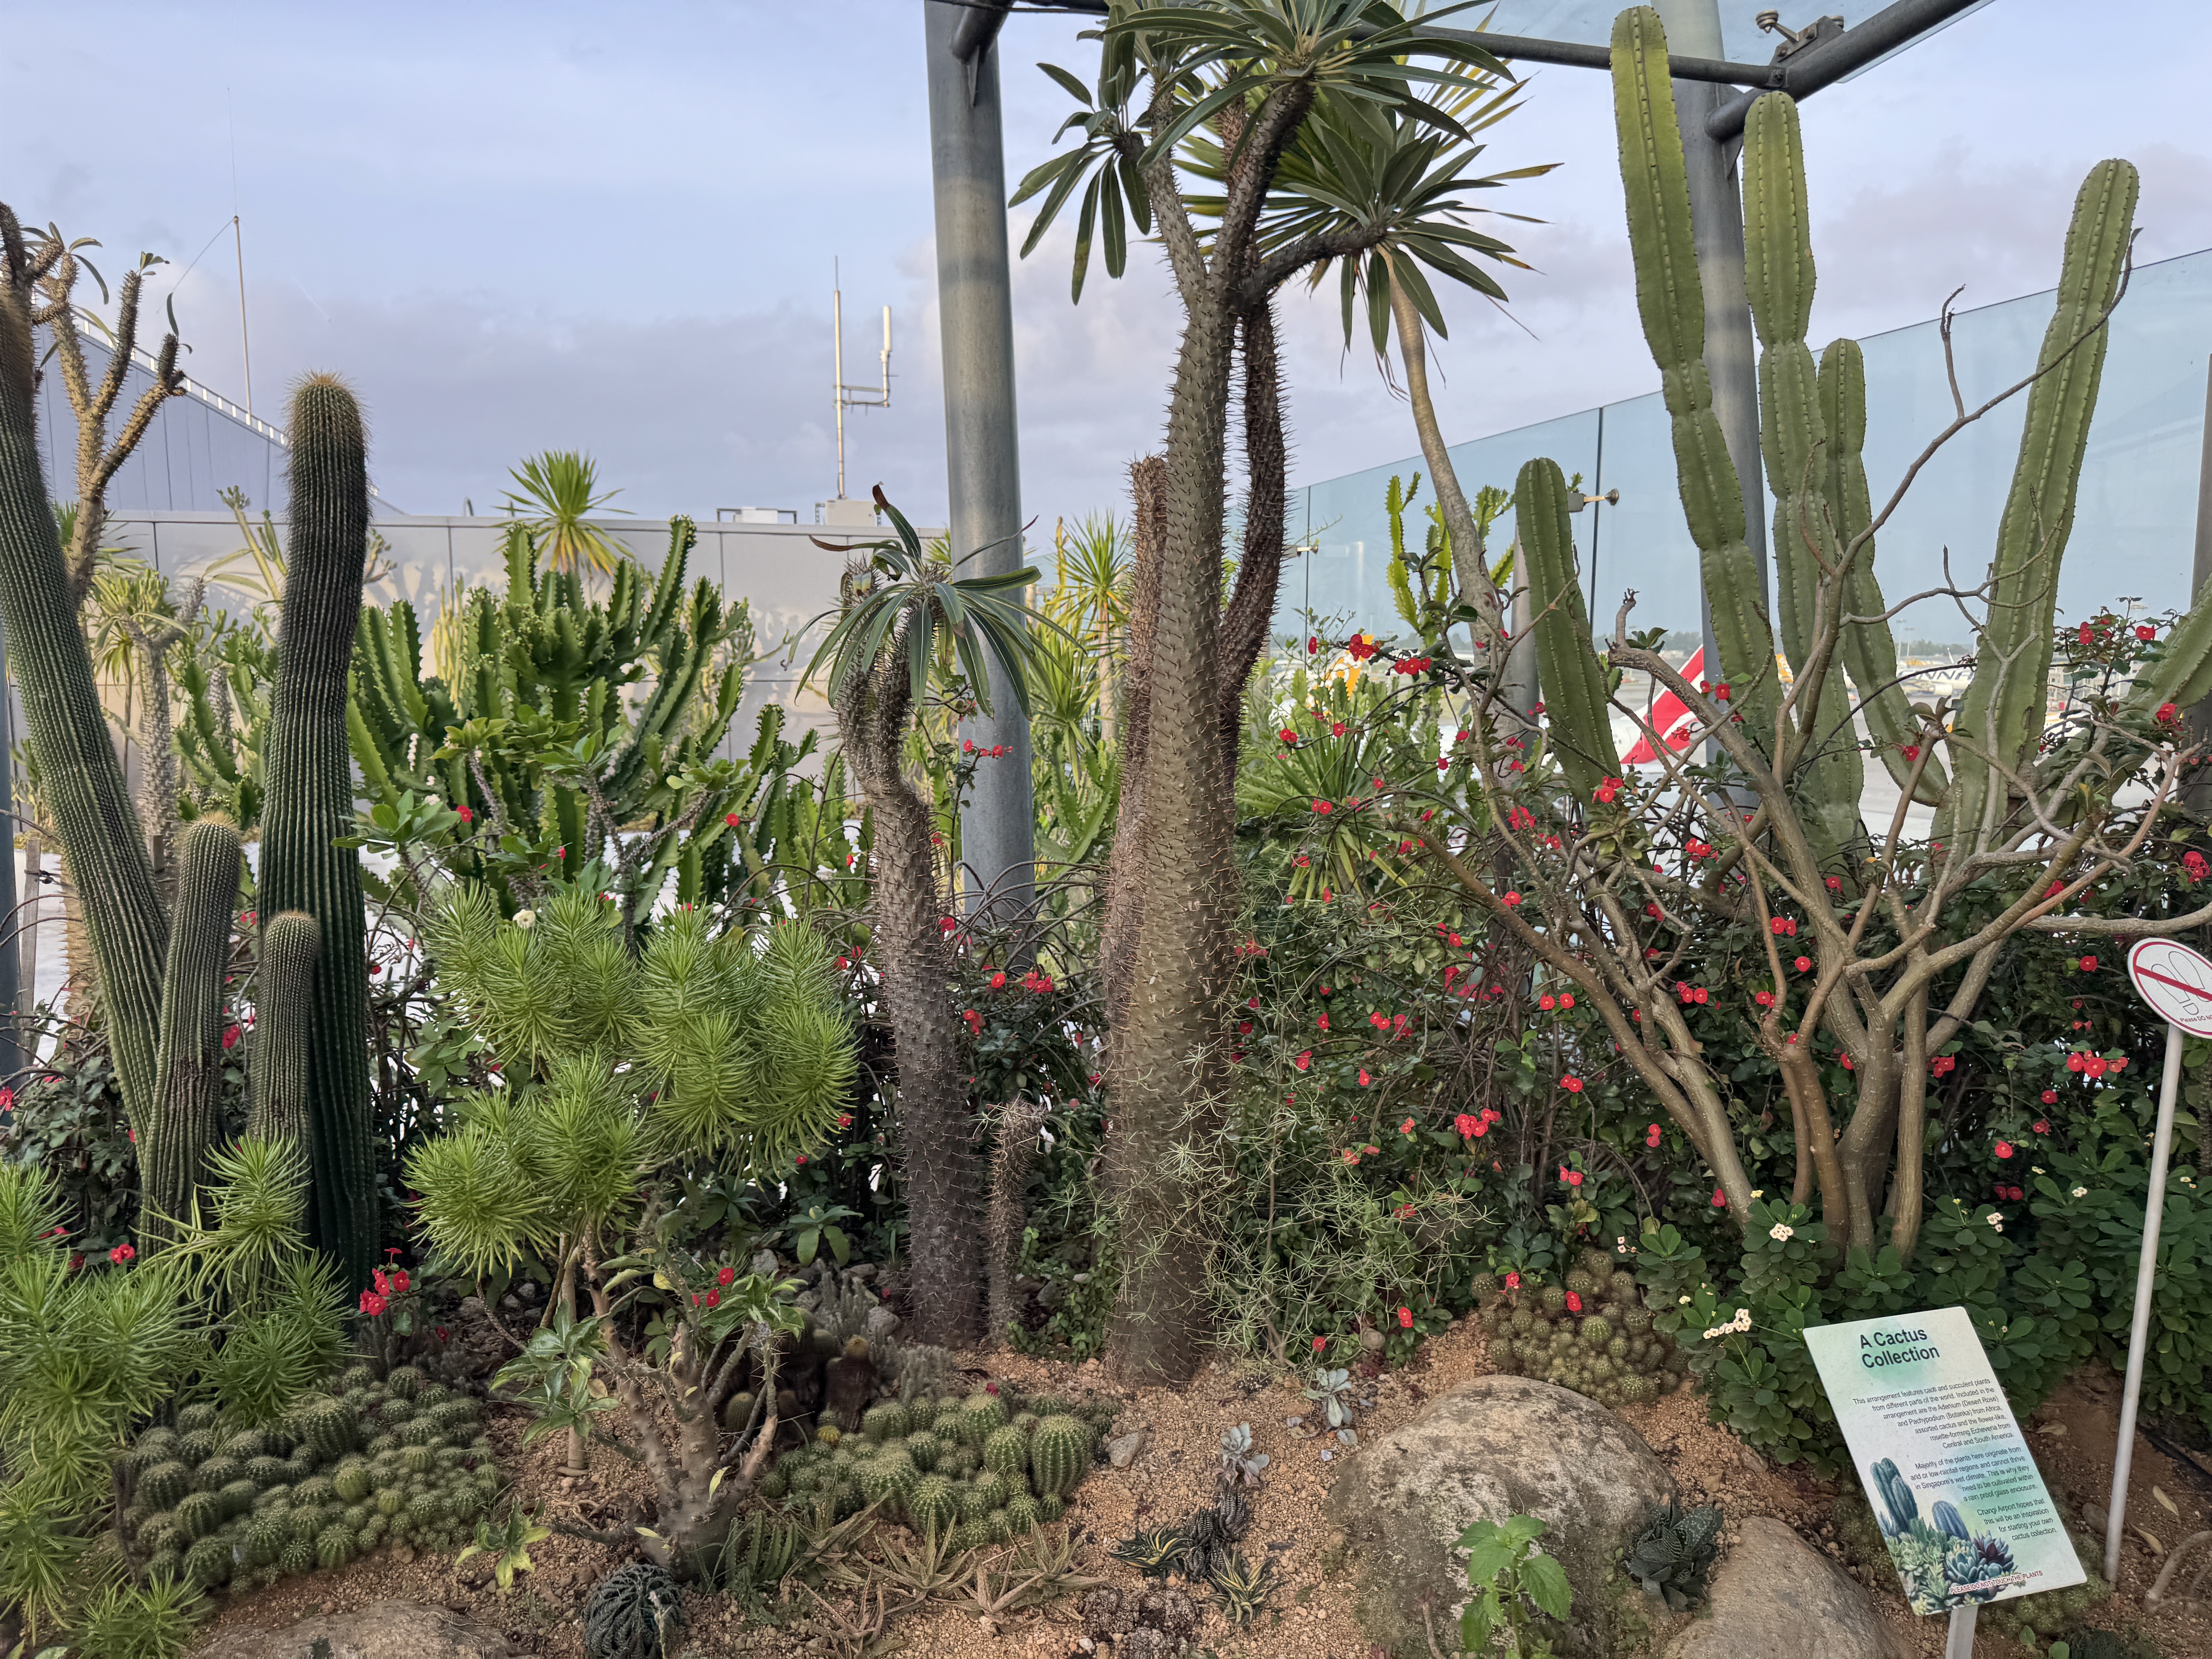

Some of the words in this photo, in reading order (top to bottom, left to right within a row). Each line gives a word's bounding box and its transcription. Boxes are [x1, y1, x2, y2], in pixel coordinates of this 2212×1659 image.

[1860, 1334, 1872, 1349] A
[1874, 1329, 1927, 1346] Cactus
[1862, 1346, 1940, 1368] Collection
[1866, 1392, 1901, 1402] arrangement
[1974, 1378, 1990, 1386] plants
[1883, 1409, 1918, 1419] arrangement
[1908, 1415, 1945, 1425] Pachypodium
[1915, 1424, 1938, 1434] assorted
[1942, 1440, 1963, 1448] Central
[1954, 1455, 1971, 1463] plants
[1985, 1449, 2008, 1457] originate
[1991, 1458, 2009, 1466] cannot
[1979, 1490, 1994, 1500] proof
[1994, 1489, 2009, 1497] glass
[2028, 1520, 2040, 1528] your
[1950, 1585, 1970, 1593] PLEASE
[1992, 1577, 2011, 1585] TOUCH
[2022, 1570, 2043, 1578] PLANTS
